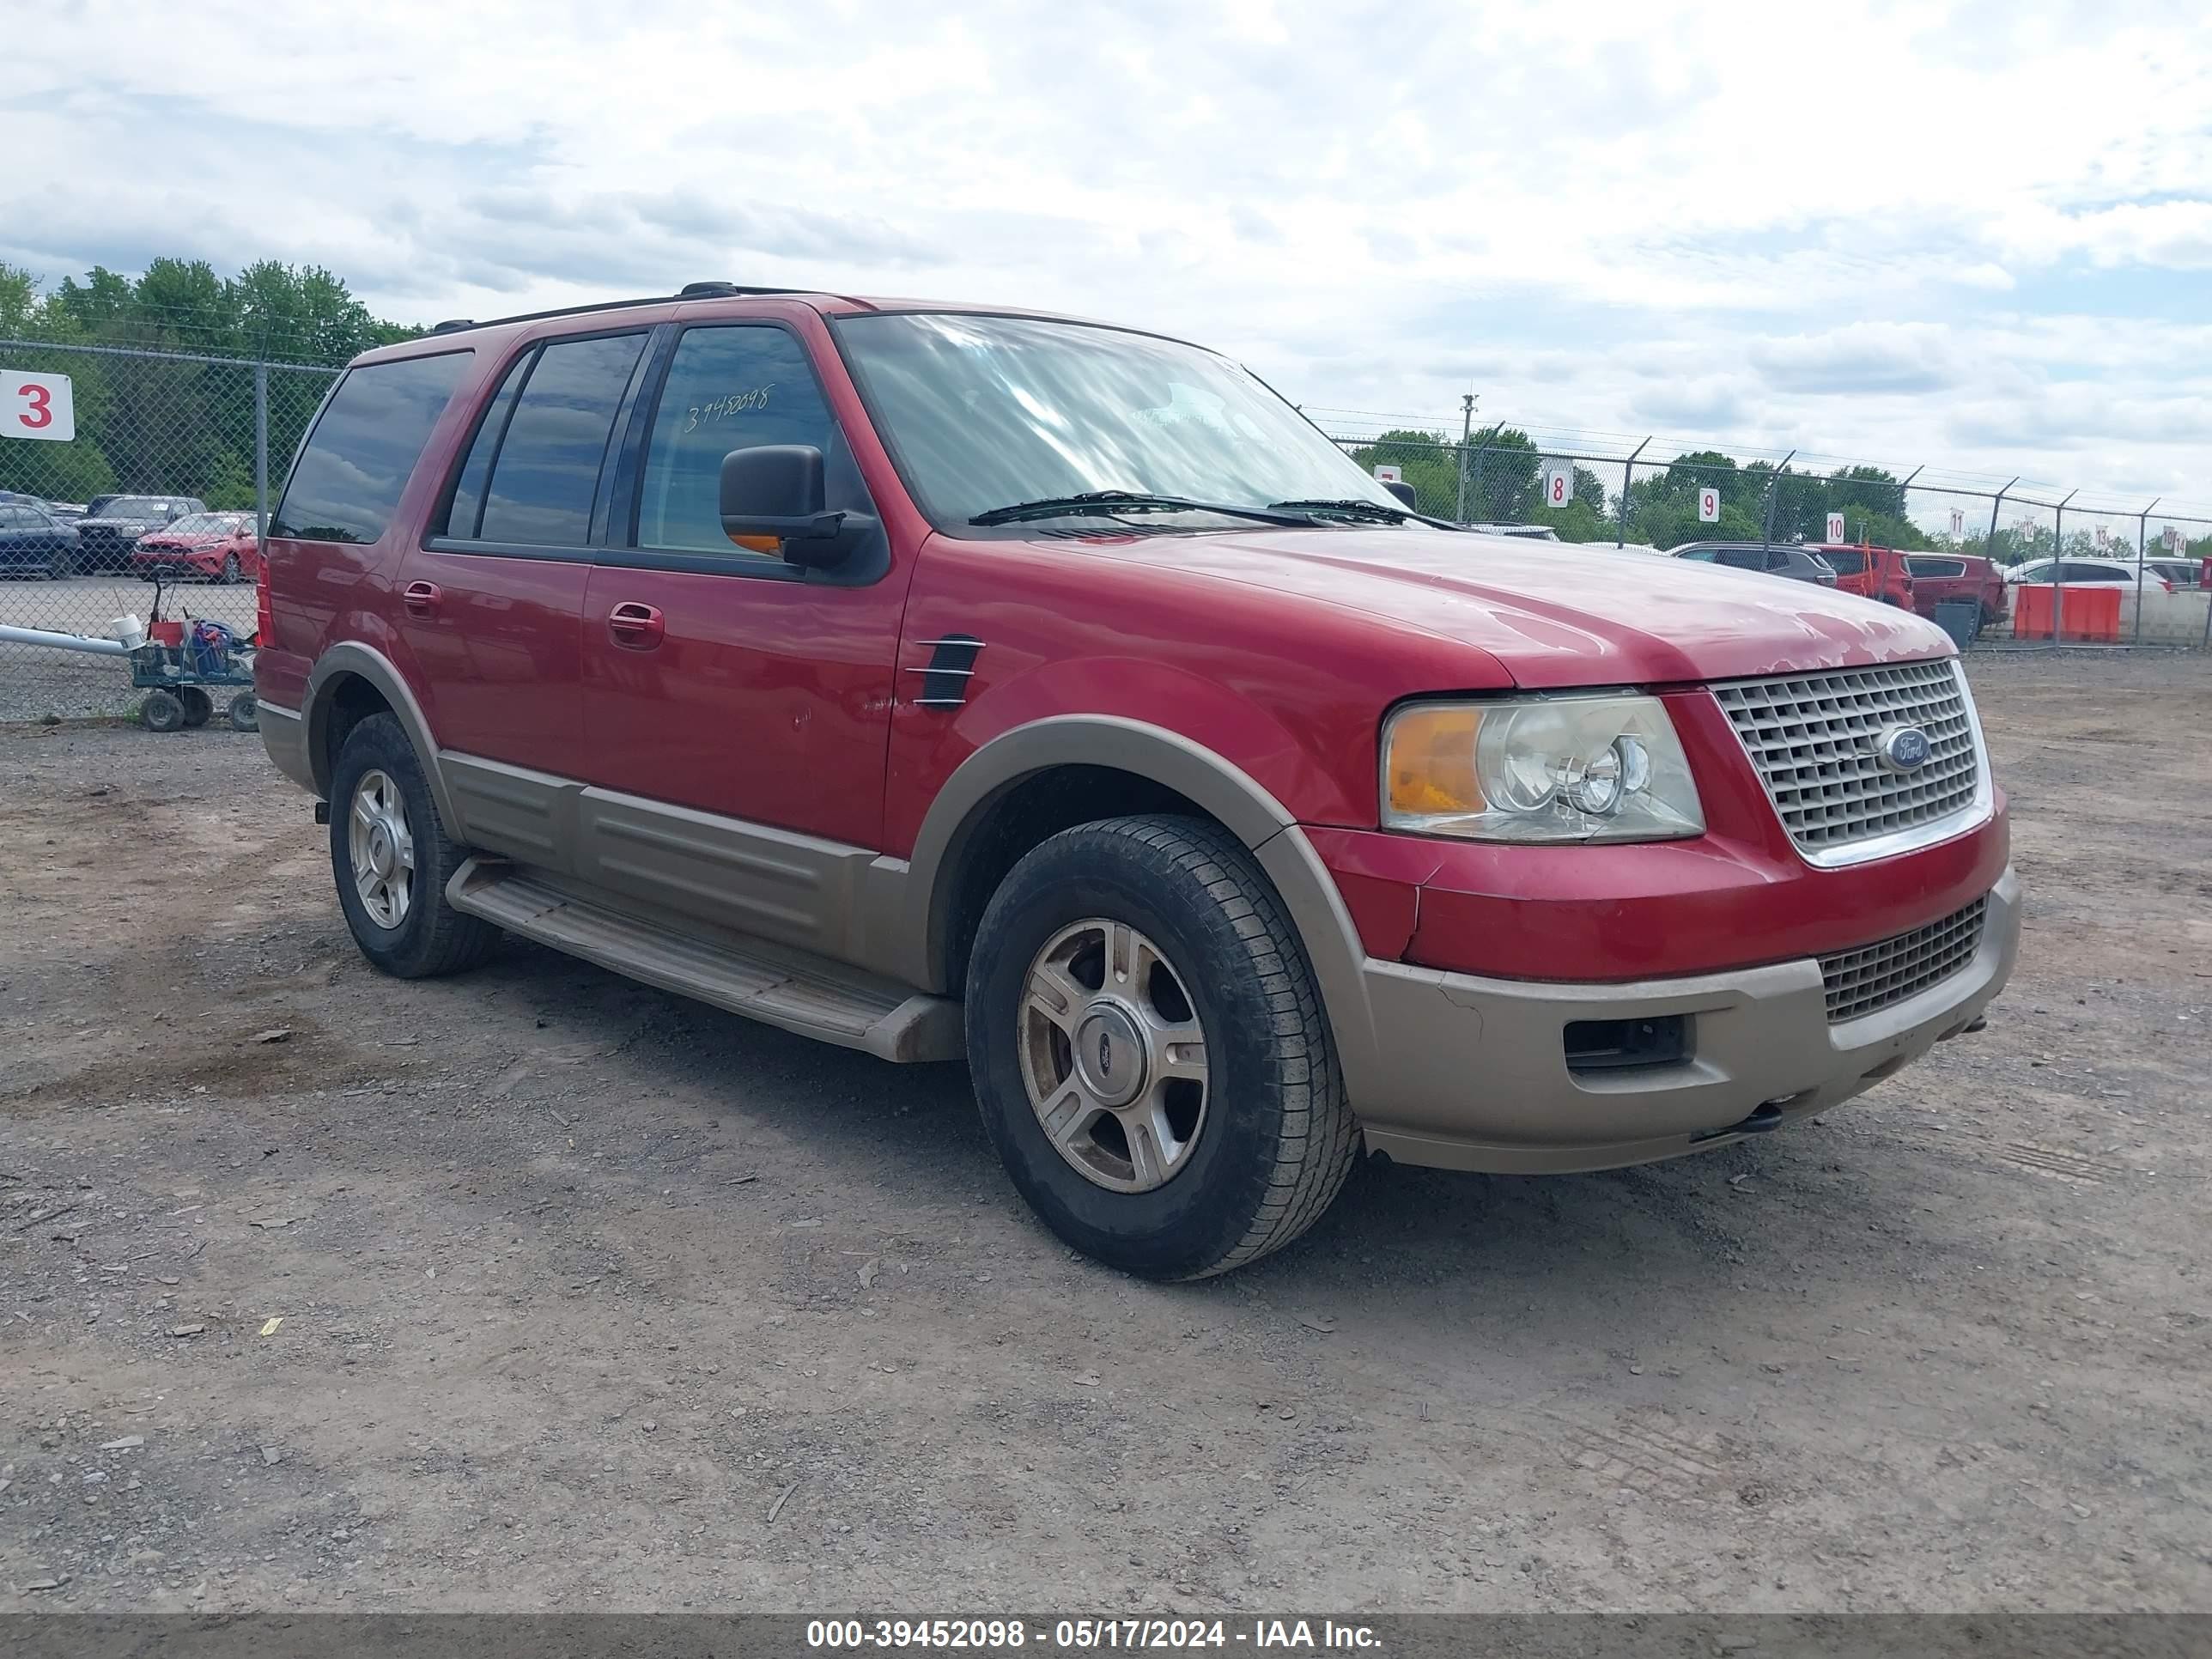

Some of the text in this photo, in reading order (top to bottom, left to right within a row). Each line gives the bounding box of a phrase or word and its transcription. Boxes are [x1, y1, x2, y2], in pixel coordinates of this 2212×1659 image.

[18, 385, 52, 428] 3
[1553, 477, 1564, 501] 8
[1705, 494, 1714, 517] 9
[1828, 520, 1843, 538] 10
[1952, 514, 1963, 533] 11
[2097, 529, 2107, 546] 13
[2176, 538, 2185, 554] 14
[1899, 737, 1923, 760] Ford
